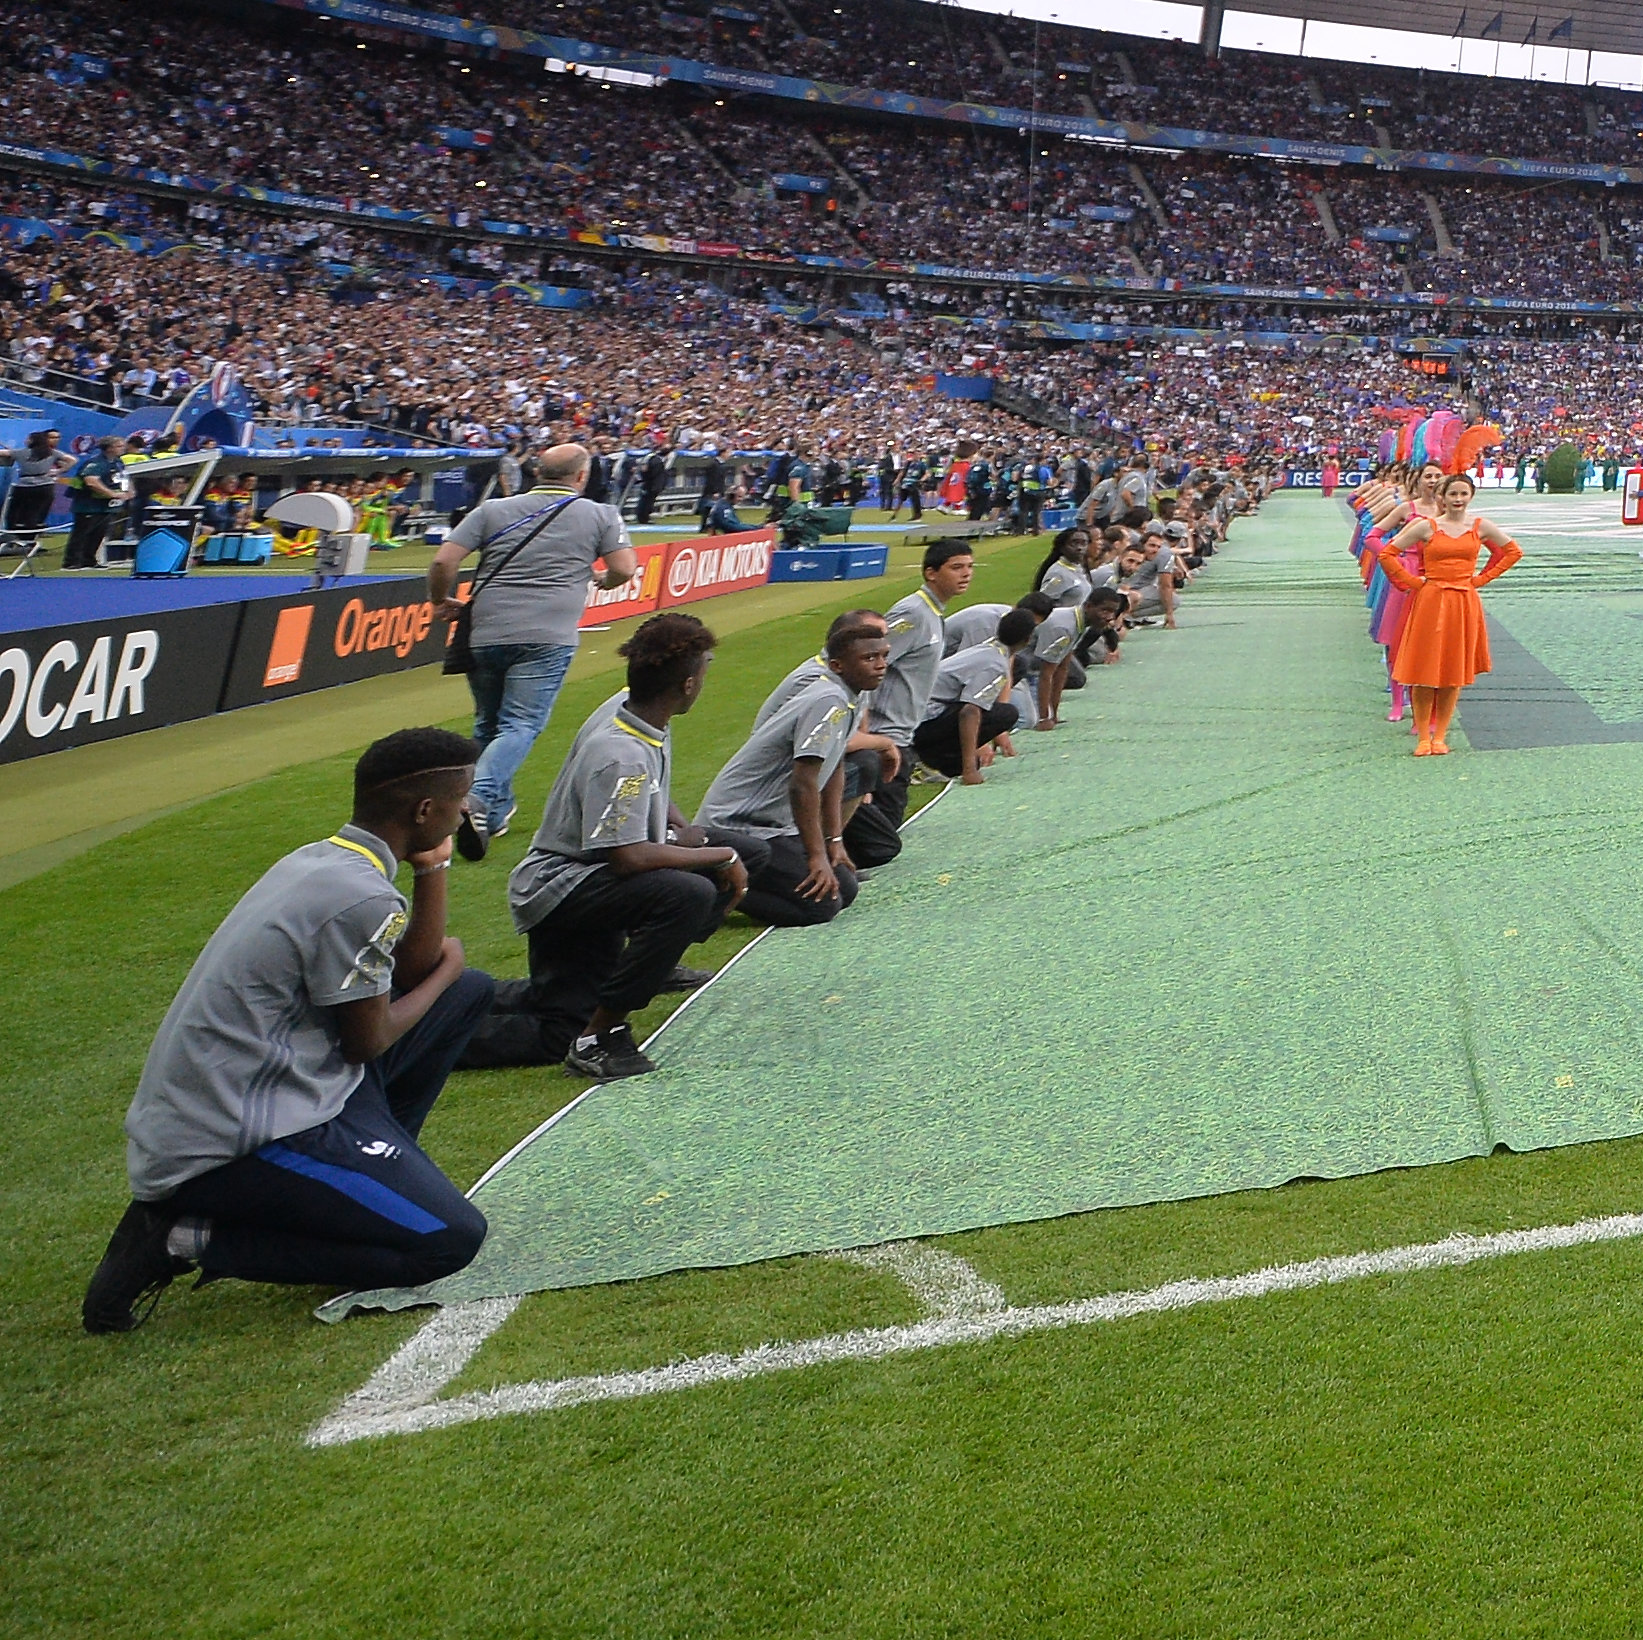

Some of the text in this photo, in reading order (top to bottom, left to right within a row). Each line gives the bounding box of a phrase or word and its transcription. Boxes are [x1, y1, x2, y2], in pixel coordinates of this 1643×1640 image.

[703, 69, 774, 89] SAINT-DENIS
[1287, 144, 1345, 156] SAINT-DENIS
[1523, 164, 1600, 177] UEFA EURO 2016
[932, 267, 1019, 281] UEFA EURO 2016
[1244, 288, 1299, 298] SAINT-DENIS
[1505, 300, 1577, 310] UEFA EURO 2016
[1292, 471, 1370, 486] RESECT
[694, 540, 772, 587] KIA MOTORS
[334, 597, 434, 658] Orange
[268, 663, 298, 681] orange
